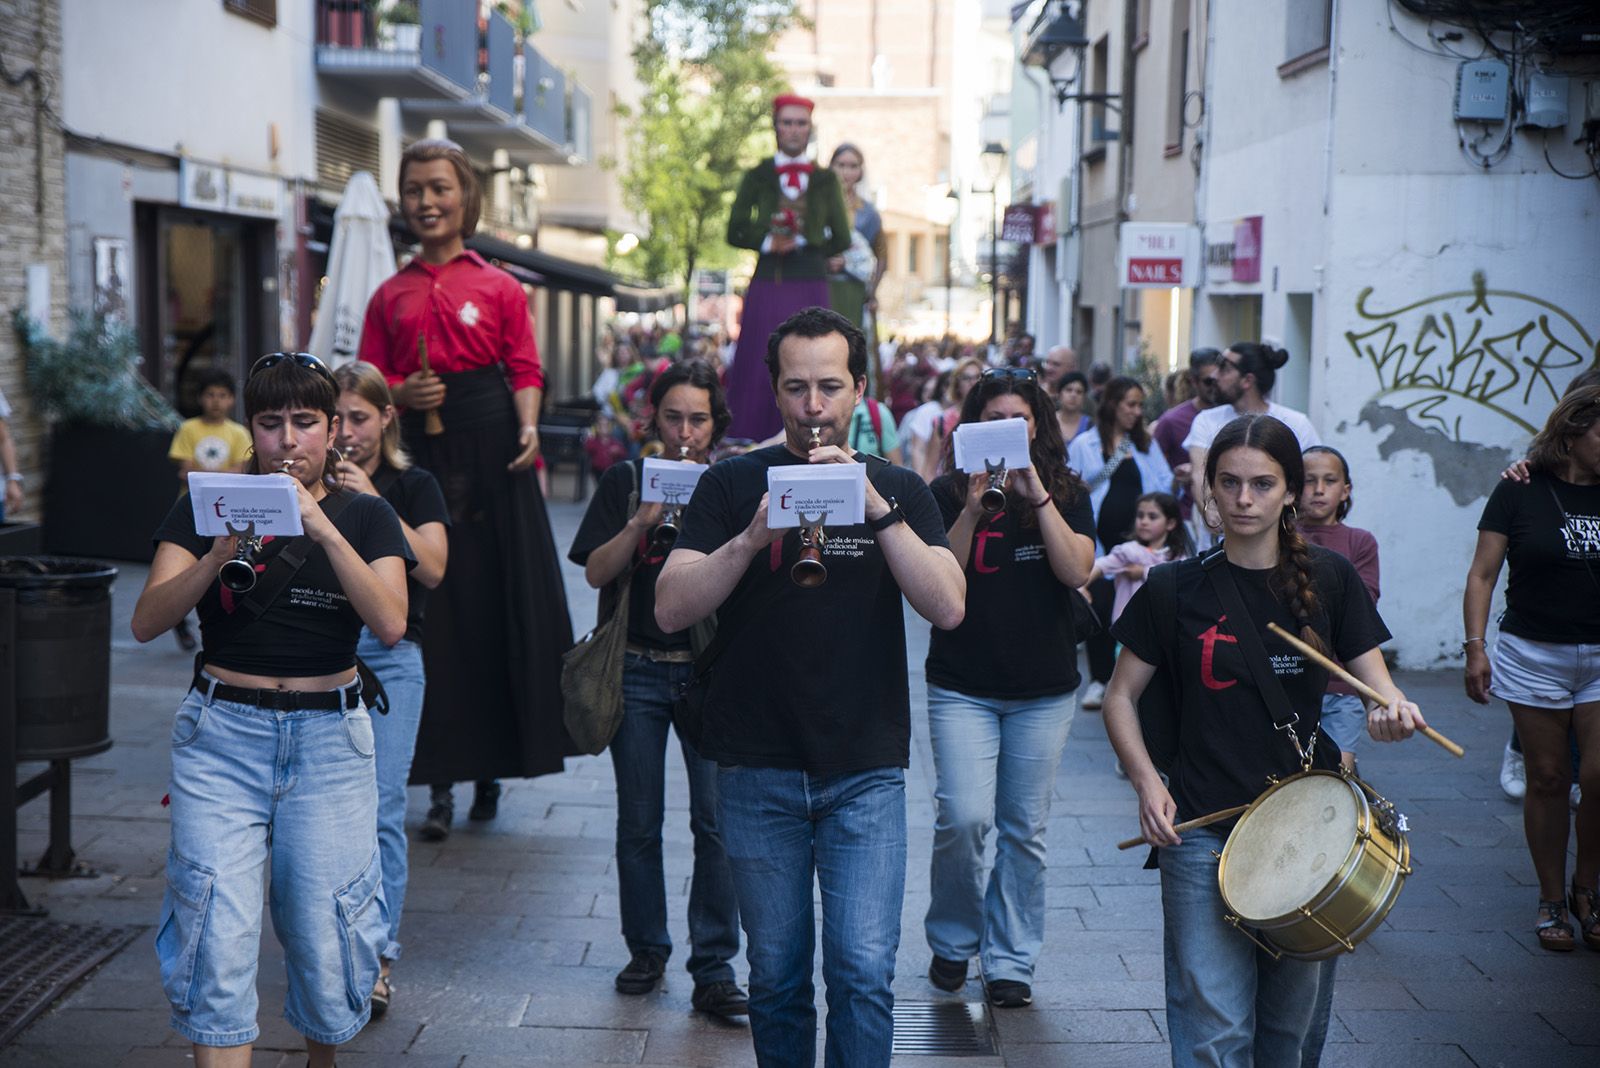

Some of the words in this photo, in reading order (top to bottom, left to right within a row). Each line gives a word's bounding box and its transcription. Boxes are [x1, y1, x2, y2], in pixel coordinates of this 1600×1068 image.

[1131, 263, 1181, 279] NAILS
[1565, 518, 1600, 531] NEW
[846, 550, 864, 558] cugat
[1282, 654, 1291, 662] de
